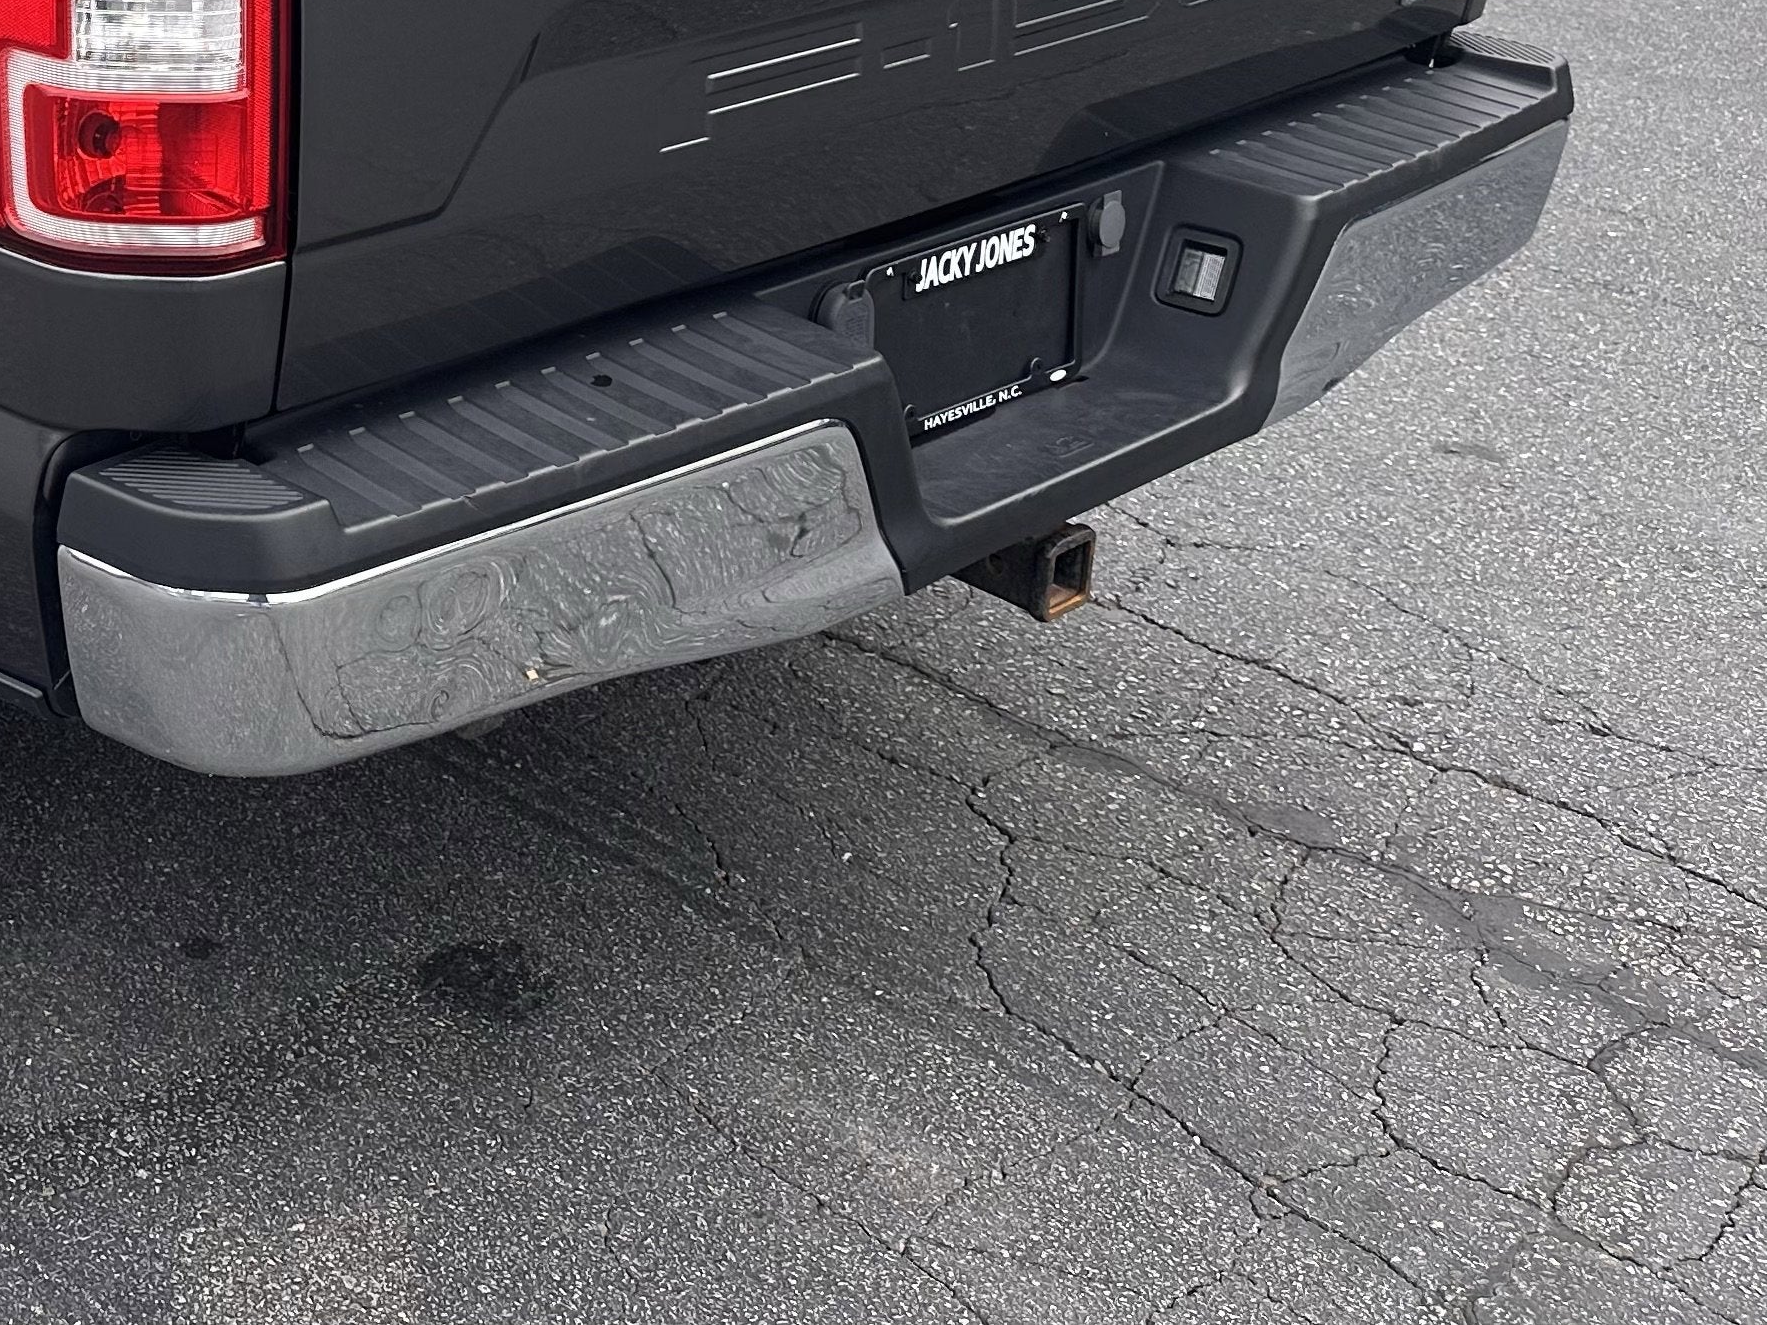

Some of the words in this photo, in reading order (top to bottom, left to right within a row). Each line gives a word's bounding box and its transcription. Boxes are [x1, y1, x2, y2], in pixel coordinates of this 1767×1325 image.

[915, 242, 980, 292] JACKY
[975, 224, 1036, 273] JONES
[923, 395, 997, 431] HAYESVILLE,
[998, 385, 1023, 403] N.C.
